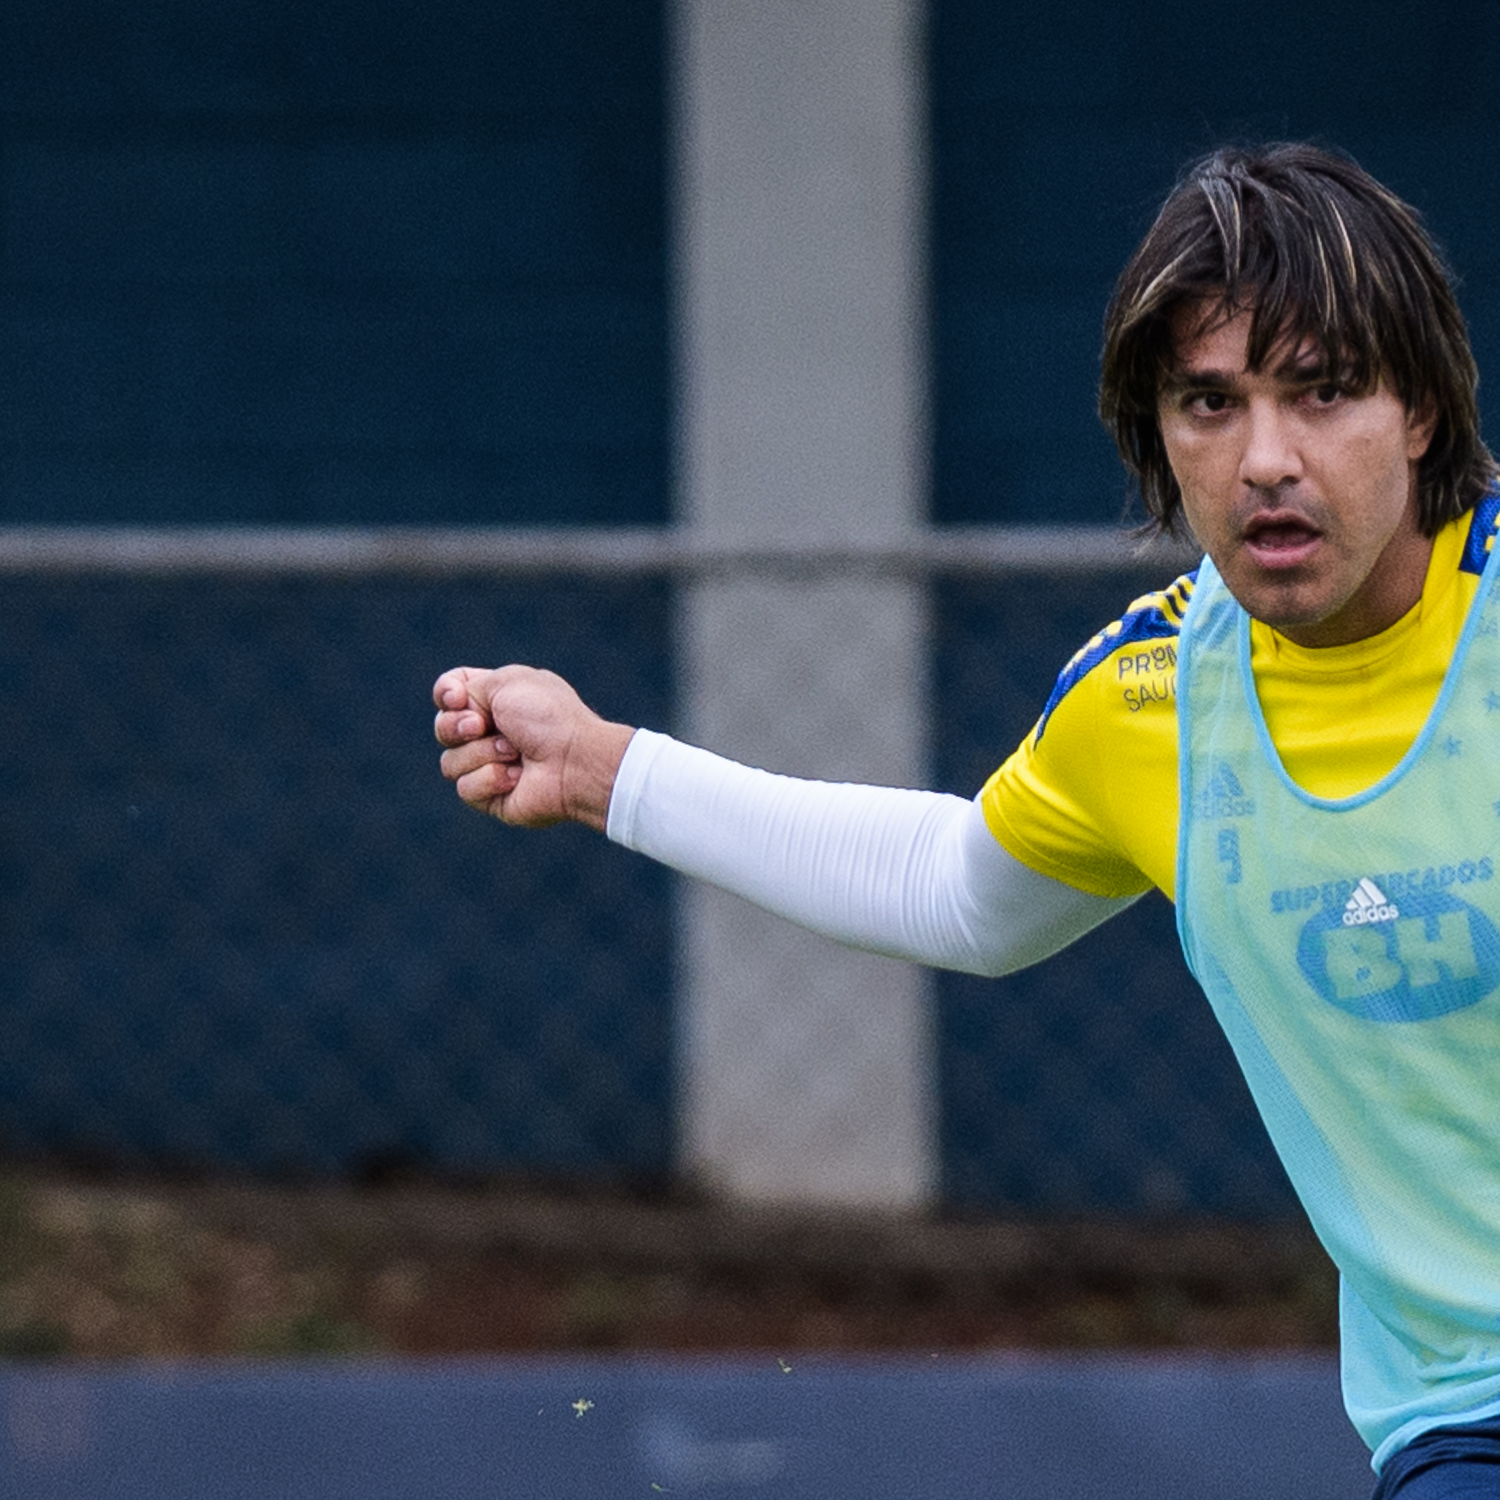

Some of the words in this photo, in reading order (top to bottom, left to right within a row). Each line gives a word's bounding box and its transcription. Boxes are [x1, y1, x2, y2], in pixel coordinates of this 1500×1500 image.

[1271, 856, 1494, 914] SUPERERCADOS
[1342, 903, 1399, 926] adidas
[1322, 911, 1479, 998] BH
